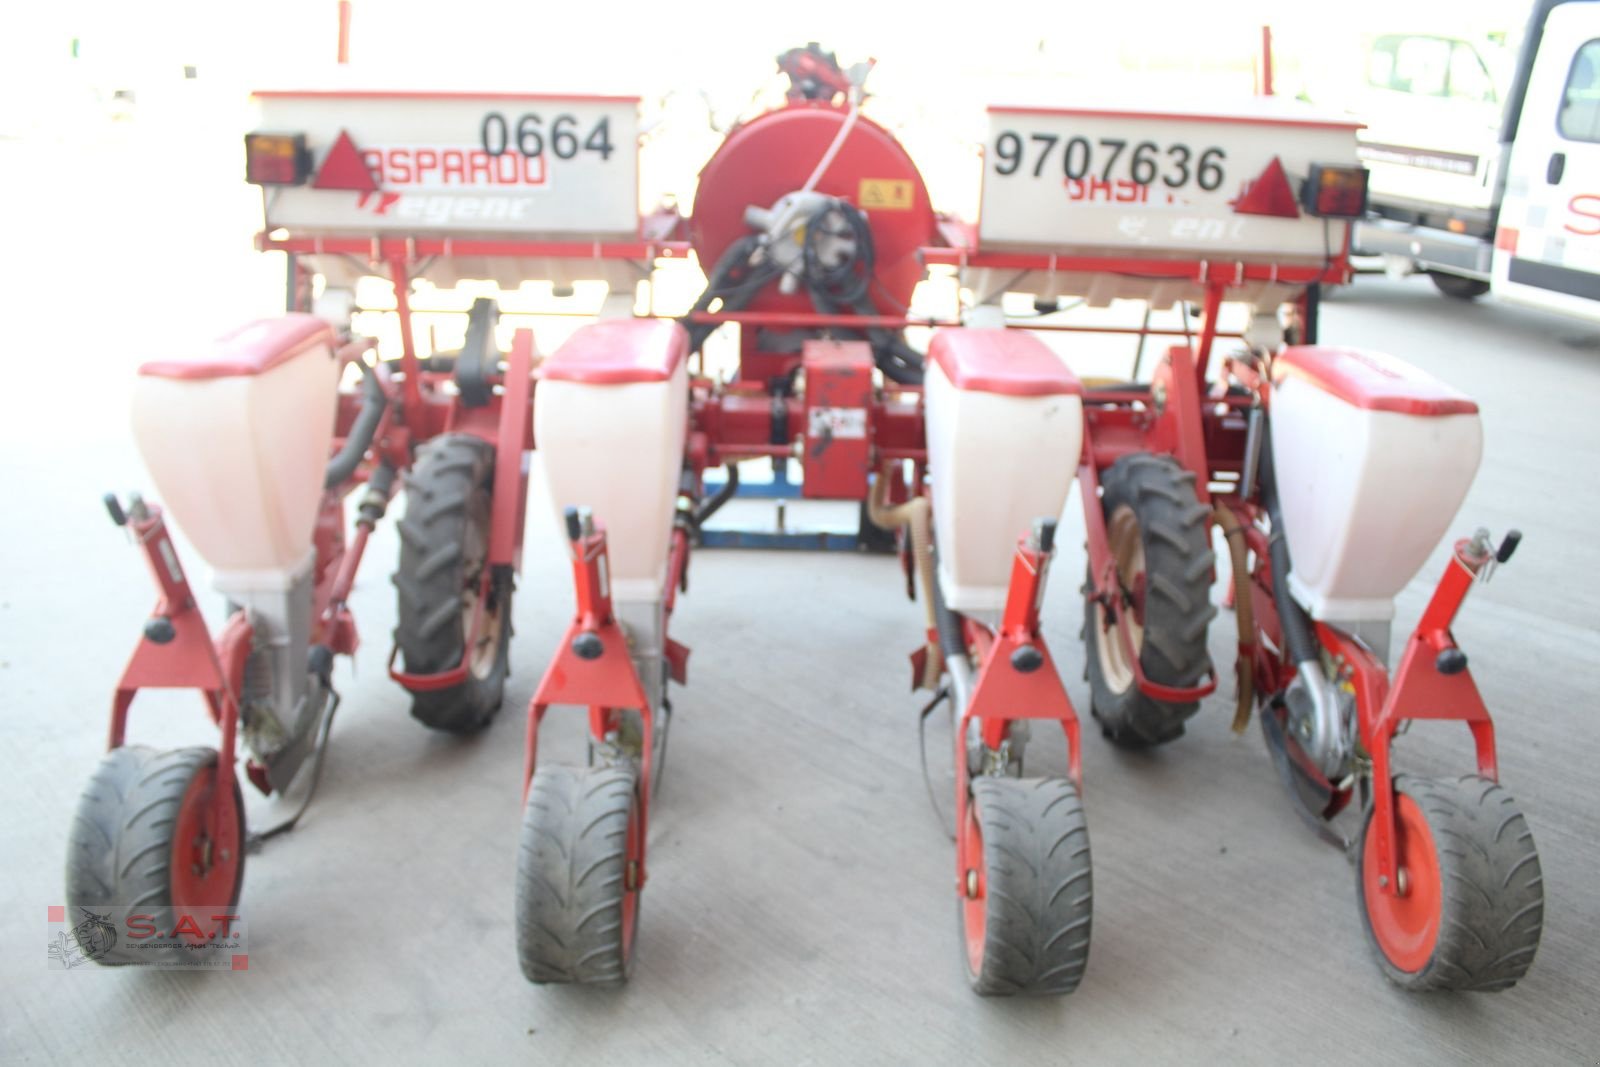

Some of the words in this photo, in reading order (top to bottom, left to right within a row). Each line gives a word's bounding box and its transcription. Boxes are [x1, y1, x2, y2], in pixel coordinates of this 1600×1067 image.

[481, 112, 614, 160] 0664
[363, 150, 546, 184] ASPARDO
[995, 130, 1227, 191] 9707636
